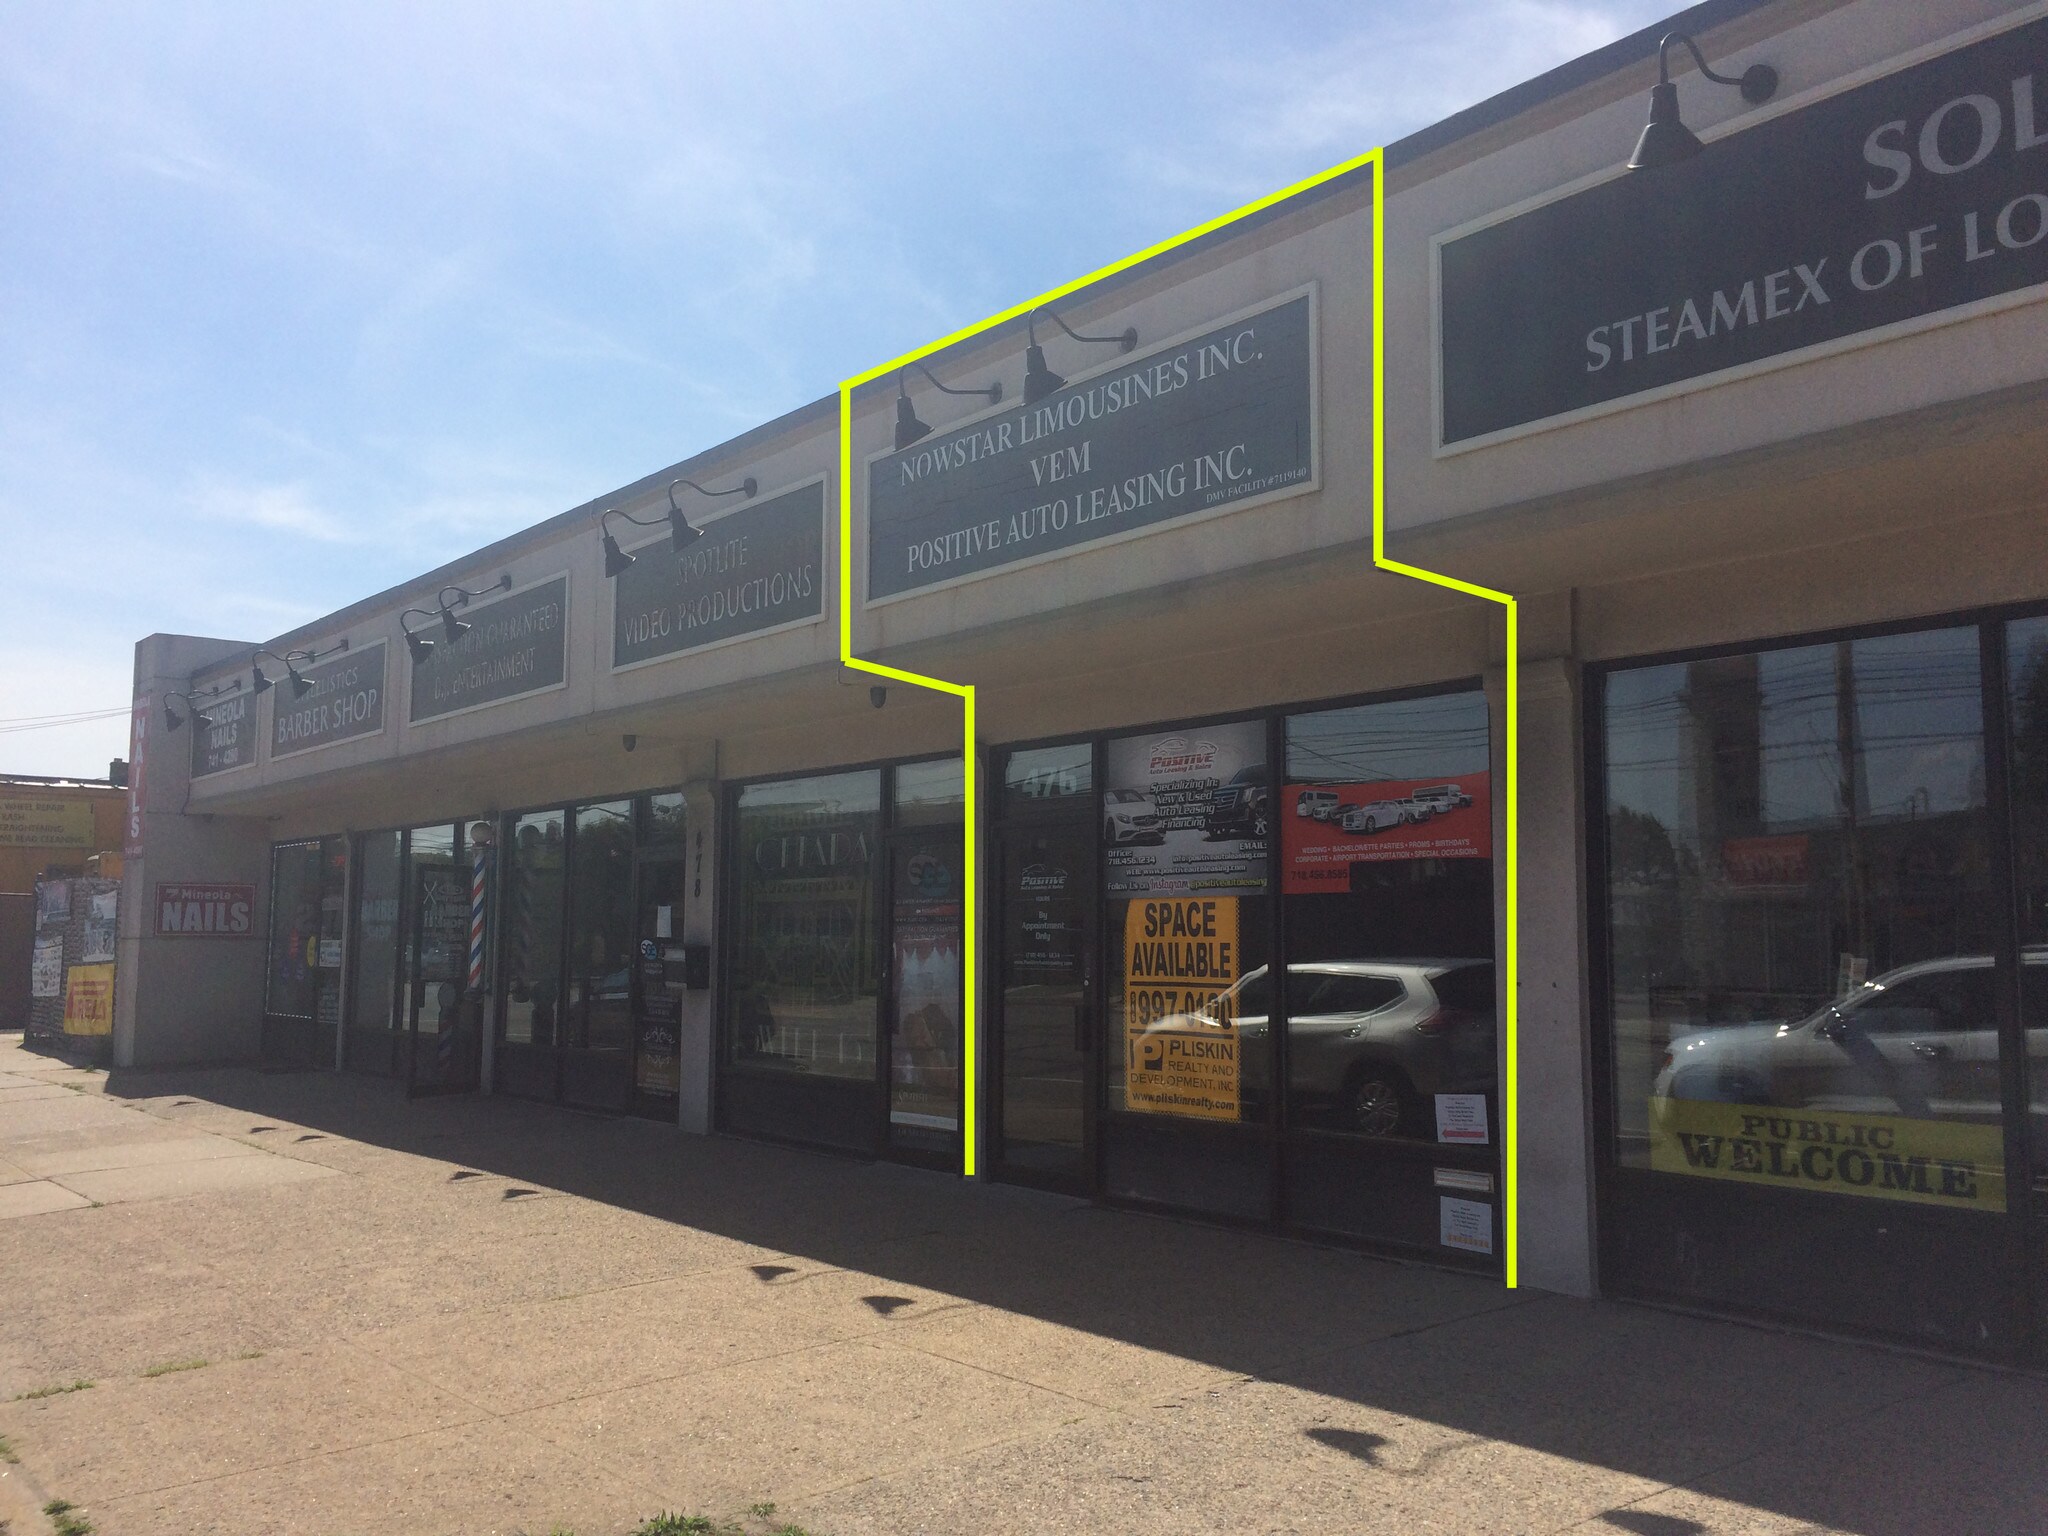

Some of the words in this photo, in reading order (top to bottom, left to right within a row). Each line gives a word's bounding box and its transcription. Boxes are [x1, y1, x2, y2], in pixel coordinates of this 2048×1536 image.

[1586, 257, 1831, 373] STEAMEX
[1850, 224, 1938, 292] OF
[1963, 192, 2048, 263] LO
[900, 422, 1013, 487] NOWSTAR
[1020, 353, 1191, 446] LIMOUSINES
[1196, 328, 1264, 382] INC.
[1030, 440, 1092, 487] VEM
[1206, 488, 1227, 503] DMV
[907, 519, 1002, 573] POSITIVE
[1005, 499, 1068, 545] AUTO
[1075, 462, 1186, 526] LEASING
[1193, 443, 1253, 492] INC.
[676, 536, 748, 586] SPOTLITE
[624, 607, 671, 647] VIDEO
[678, 564, 812, 632] PRODUCTIONS
[452, 647, 537, 695] ENTERTAINMENT
[278, 705, 329, 743] BARBER
[333, 689, 377, 728] SHOP
[211, 722, 238, 750] NAILS
[131, 716, 146, 839] NAILS
[1022, 766, 1077, 798] 476
[1150, 779, 1204, 793] Specializing
[36, 803, 65, 812] REPAIR
[1157, 795, 1176, 804] New
[1178, 793, 1185, 801] &
[1188, 791, 1212, 802] Used
[1154, 806, 1176, 817] Auto
[1179, 804, 1215, 815] Leasing
[1162, 817, 1205, 828] Financing
[1239, 842, 1268, 850] EMAIL:
[1295, 855, 1329, 863] CORPORATE
[1332, 853, 1357, 861] AIRPORT
[1358, 851, 1411, 860] TRANSPORTATION
[1414, 849, 1440, 858] SPECIAL
[1441, 847, 1478, 856] OCCASIONS
[1302, 846, 1328, 854] WEDDING
[1380, 841, 1405, 850] PARTIES
[1408, 840, 1431, 848] PROMS
[1435, 838, 1470, 847] BIRTHDAYS
[181, 889, 231, 900] Mineola
[1108, 882, 1127, 890] Follow
[1149, 877, 1190, 894] Instagram
[162, 901, 249, 933] NAILS
[1038, 911, 1048, 921] By
[1144, 901, 1216, 938] SPACE
[1022, 922, 1065, 932] Appointment
[1035, 932, 1051, 942] Only
[1131, 942, 1231, 978] AVAILABLE
[1168, 1040, 1233, 1061] PLISKIN
[1168, 1061, 1209, 1074] REALTY
[1212, 1062, 1233, 1077] AND
[1132, 1091, 1235, 1112] www.pliskinrealty.com
[1741, 1114, 1894, 1150] PUBLIC
[1677, 1132, 1978, 1200] WELCOME
